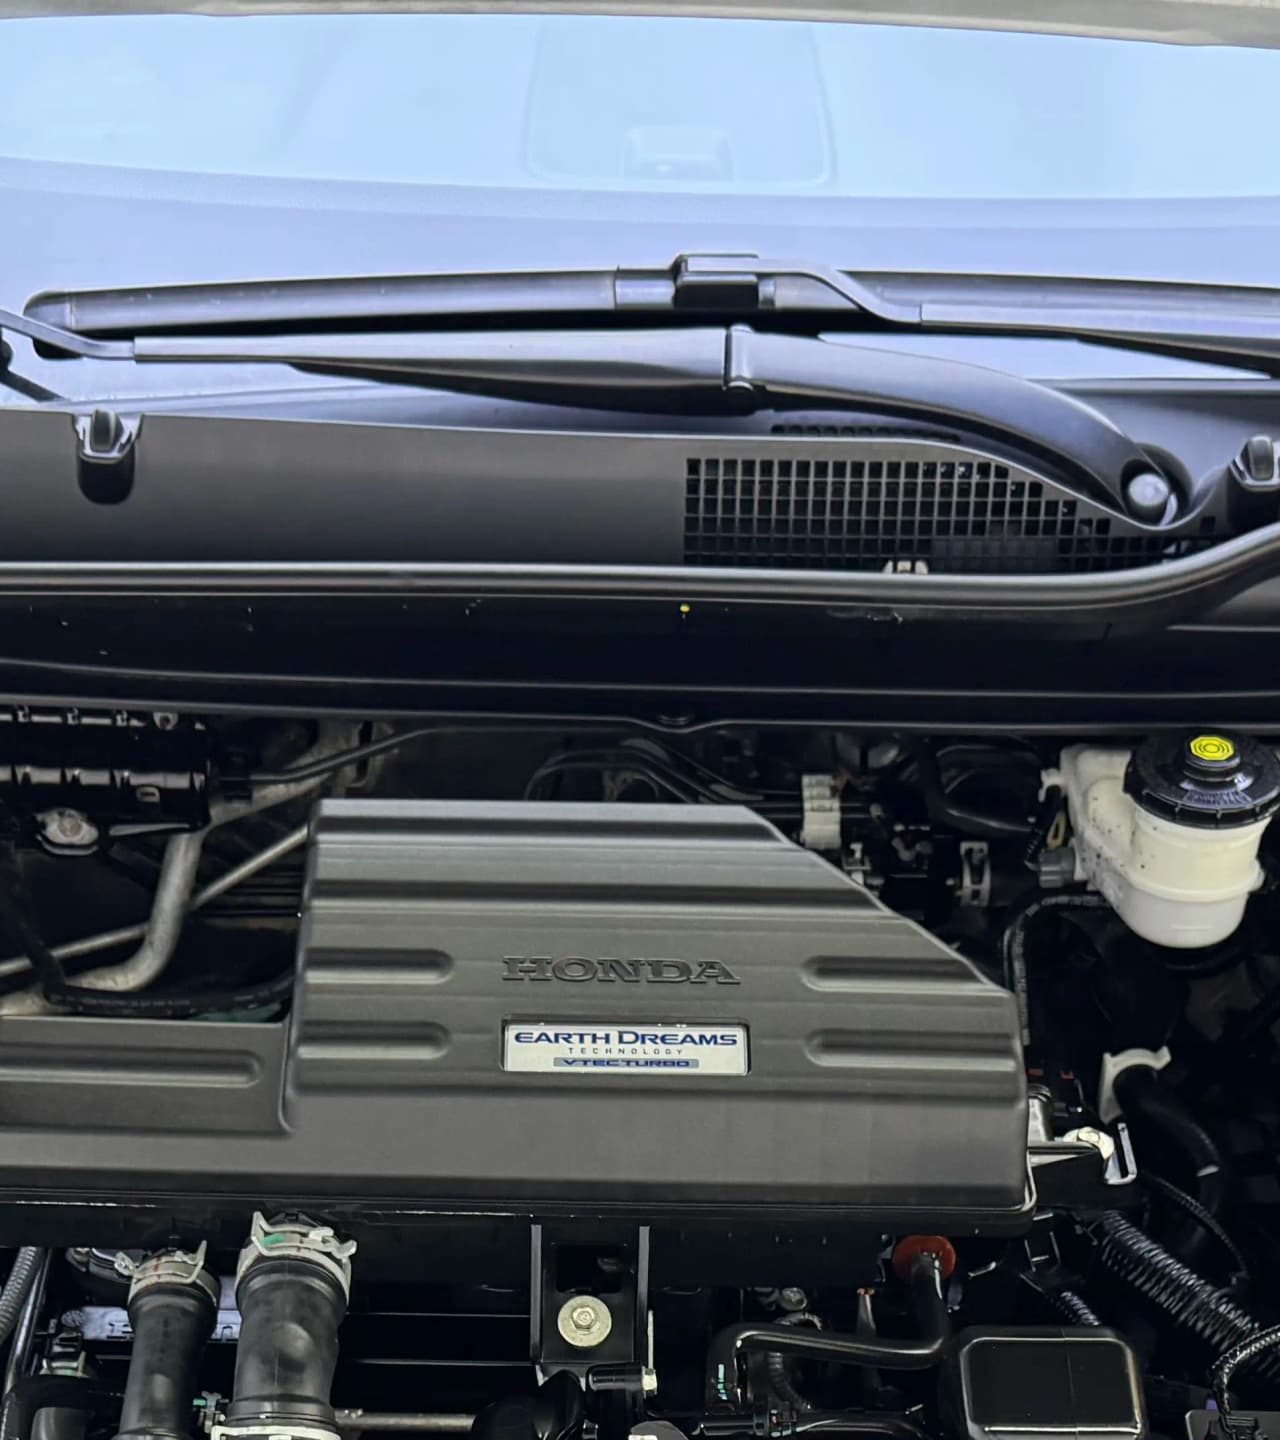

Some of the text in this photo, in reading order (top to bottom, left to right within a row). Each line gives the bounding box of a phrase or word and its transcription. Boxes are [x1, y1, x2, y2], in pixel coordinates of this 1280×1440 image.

[502, 956, 741, 985] HONDA
[514, 1030, 738, 1047] EARTH DREAMS
[569, 1047, 683, 1056] TECHNOLOGY
